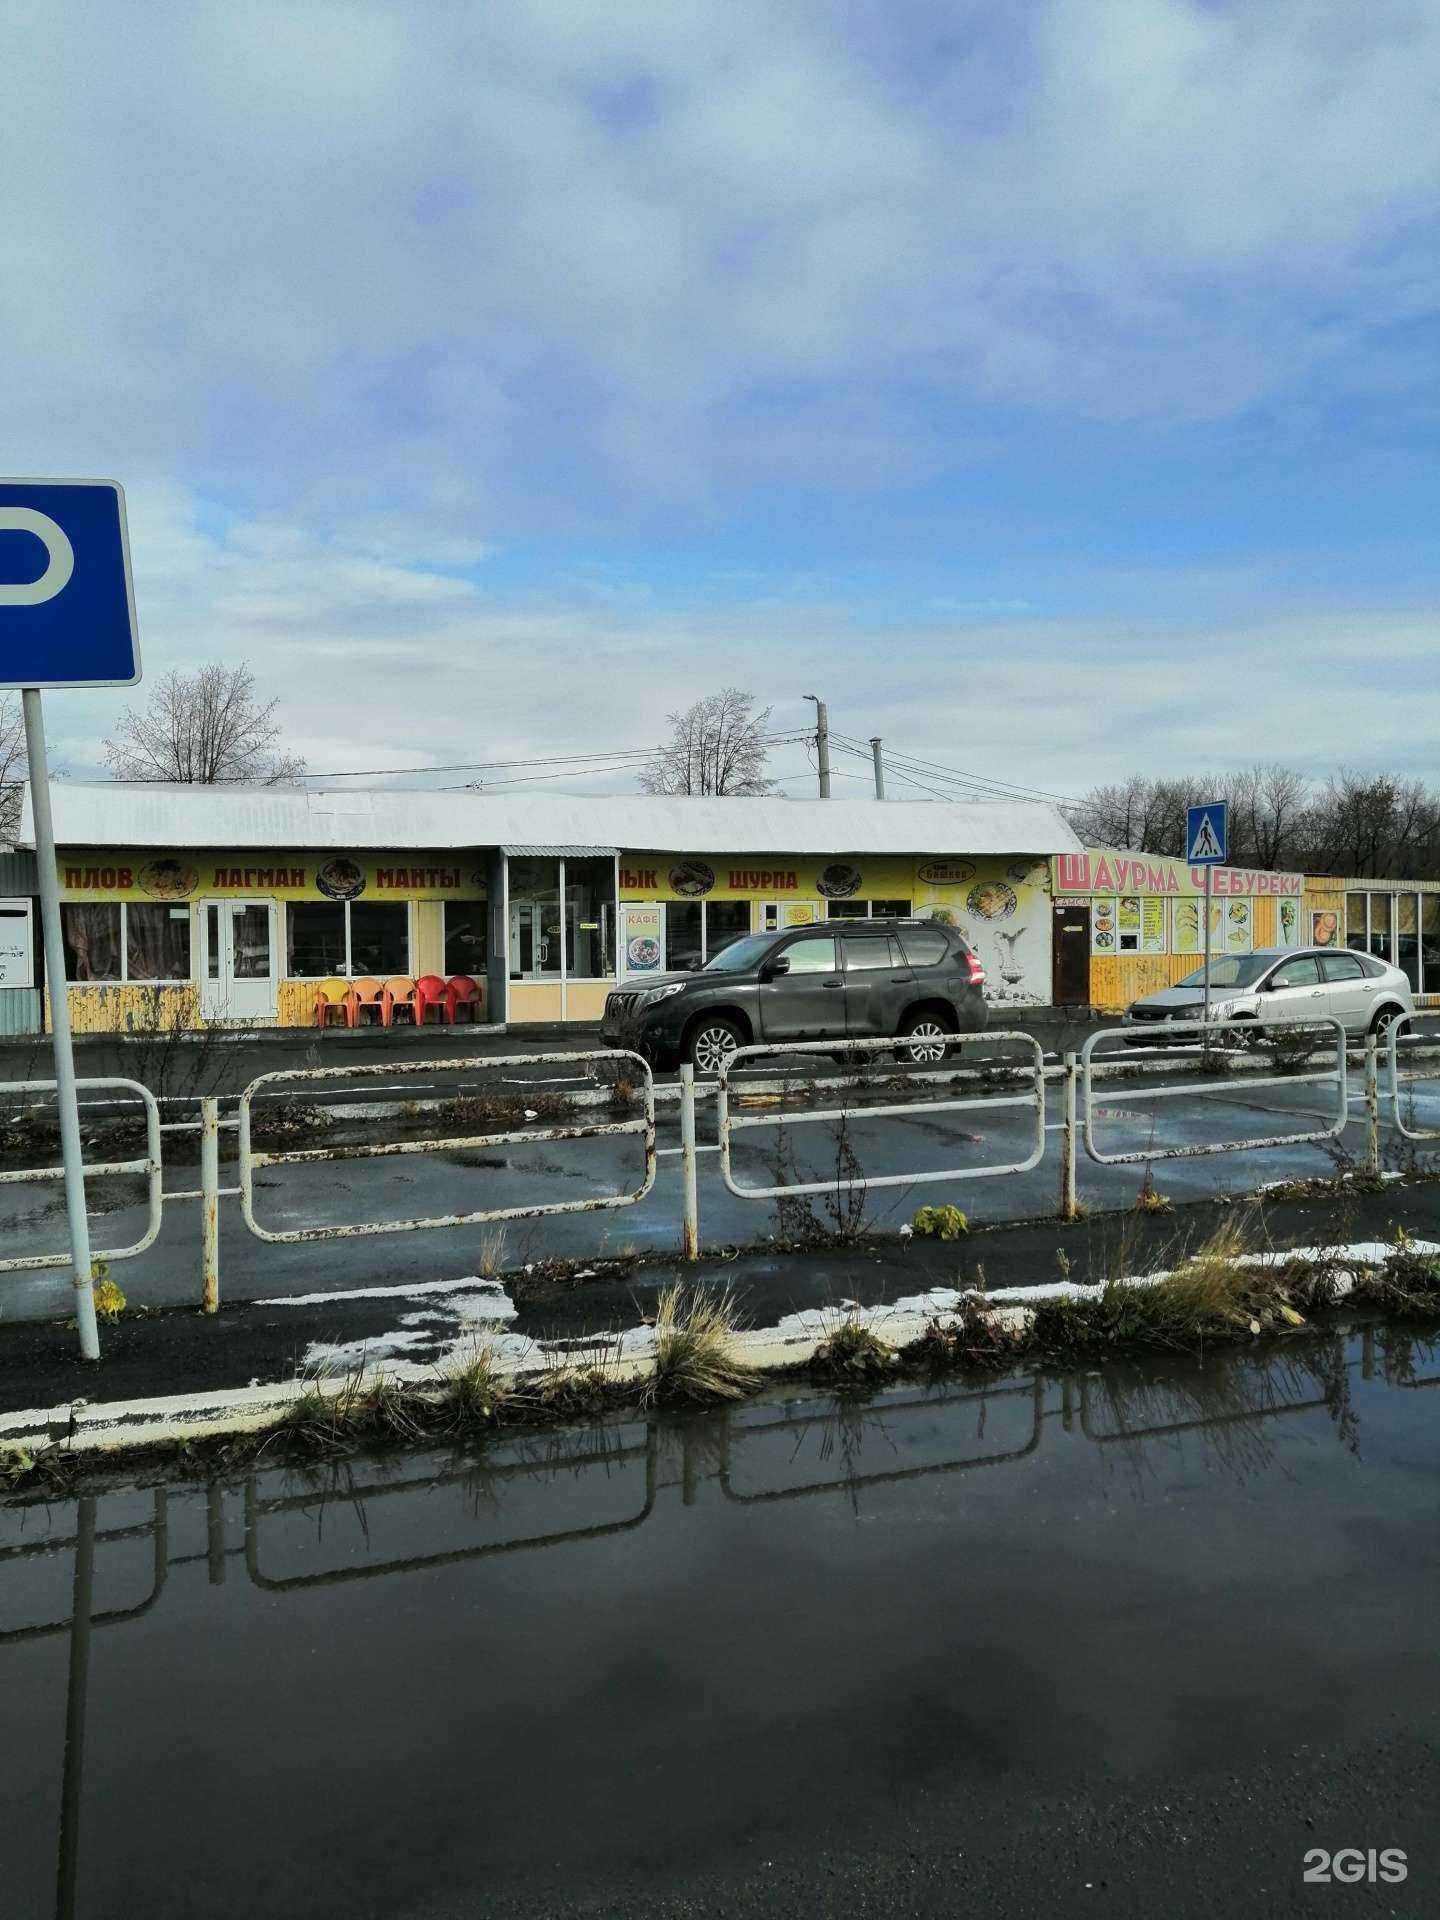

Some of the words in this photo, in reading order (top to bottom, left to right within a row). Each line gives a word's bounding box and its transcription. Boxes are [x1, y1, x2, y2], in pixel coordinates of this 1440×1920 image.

[65, 868, 133, 888] ПЛОВ
[213, 868, 306, 888] ЛАГМАН
[376, 868, 461, 888] МАНТЫ
[729, 870, 798, 889] ШУРПА
[1059, 854, 1179, 892] ШАУРМА
[1191, 867, 1300, 895] ЧЕБУРЕКИ
[628, 914, 658, 924] КАФЕ
